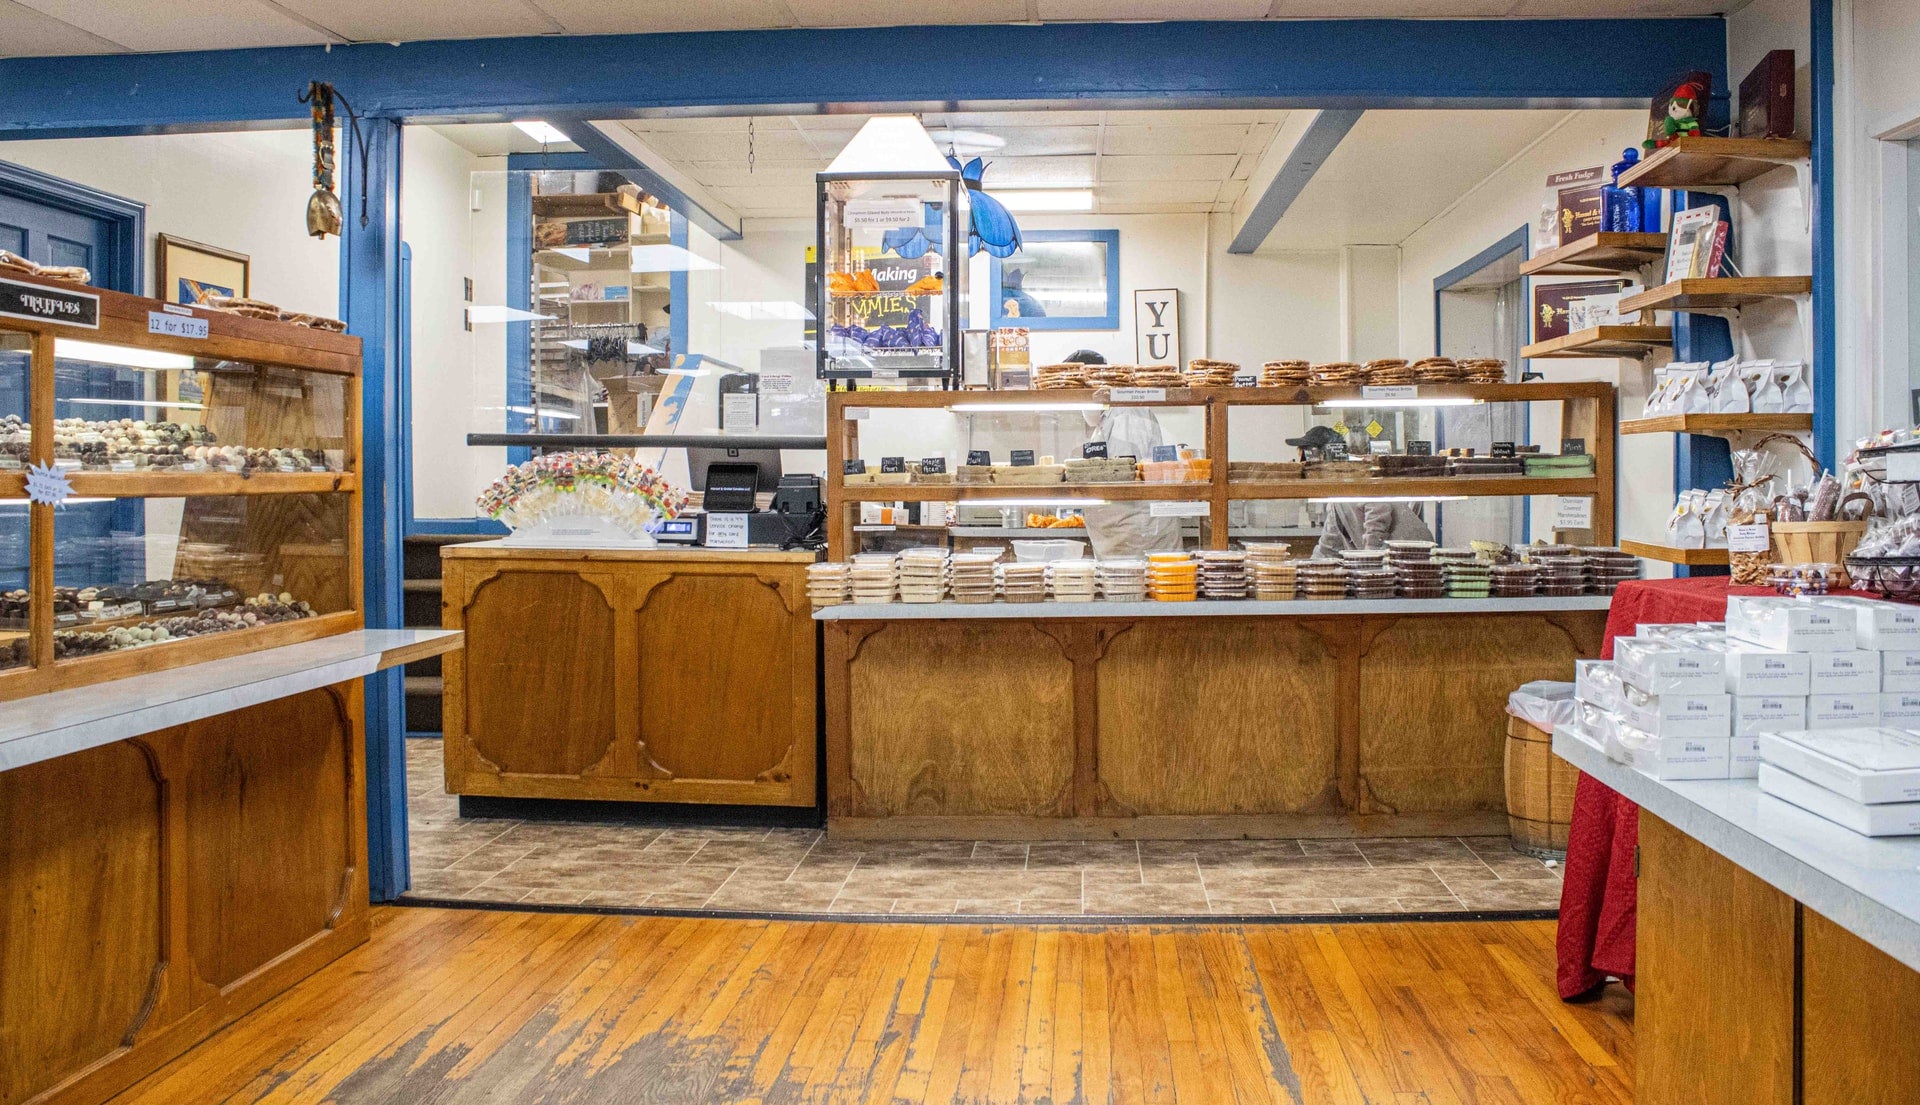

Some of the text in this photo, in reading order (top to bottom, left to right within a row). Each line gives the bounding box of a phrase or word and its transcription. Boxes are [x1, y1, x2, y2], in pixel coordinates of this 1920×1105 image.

[1555, 171, 1595, 183] Fresh Fudge
[20, 294, 80, 316] TRUFFLES
[151, 319, 208, 337] 12 for $17.95
[1563, 442, 1583, 451] Mint
